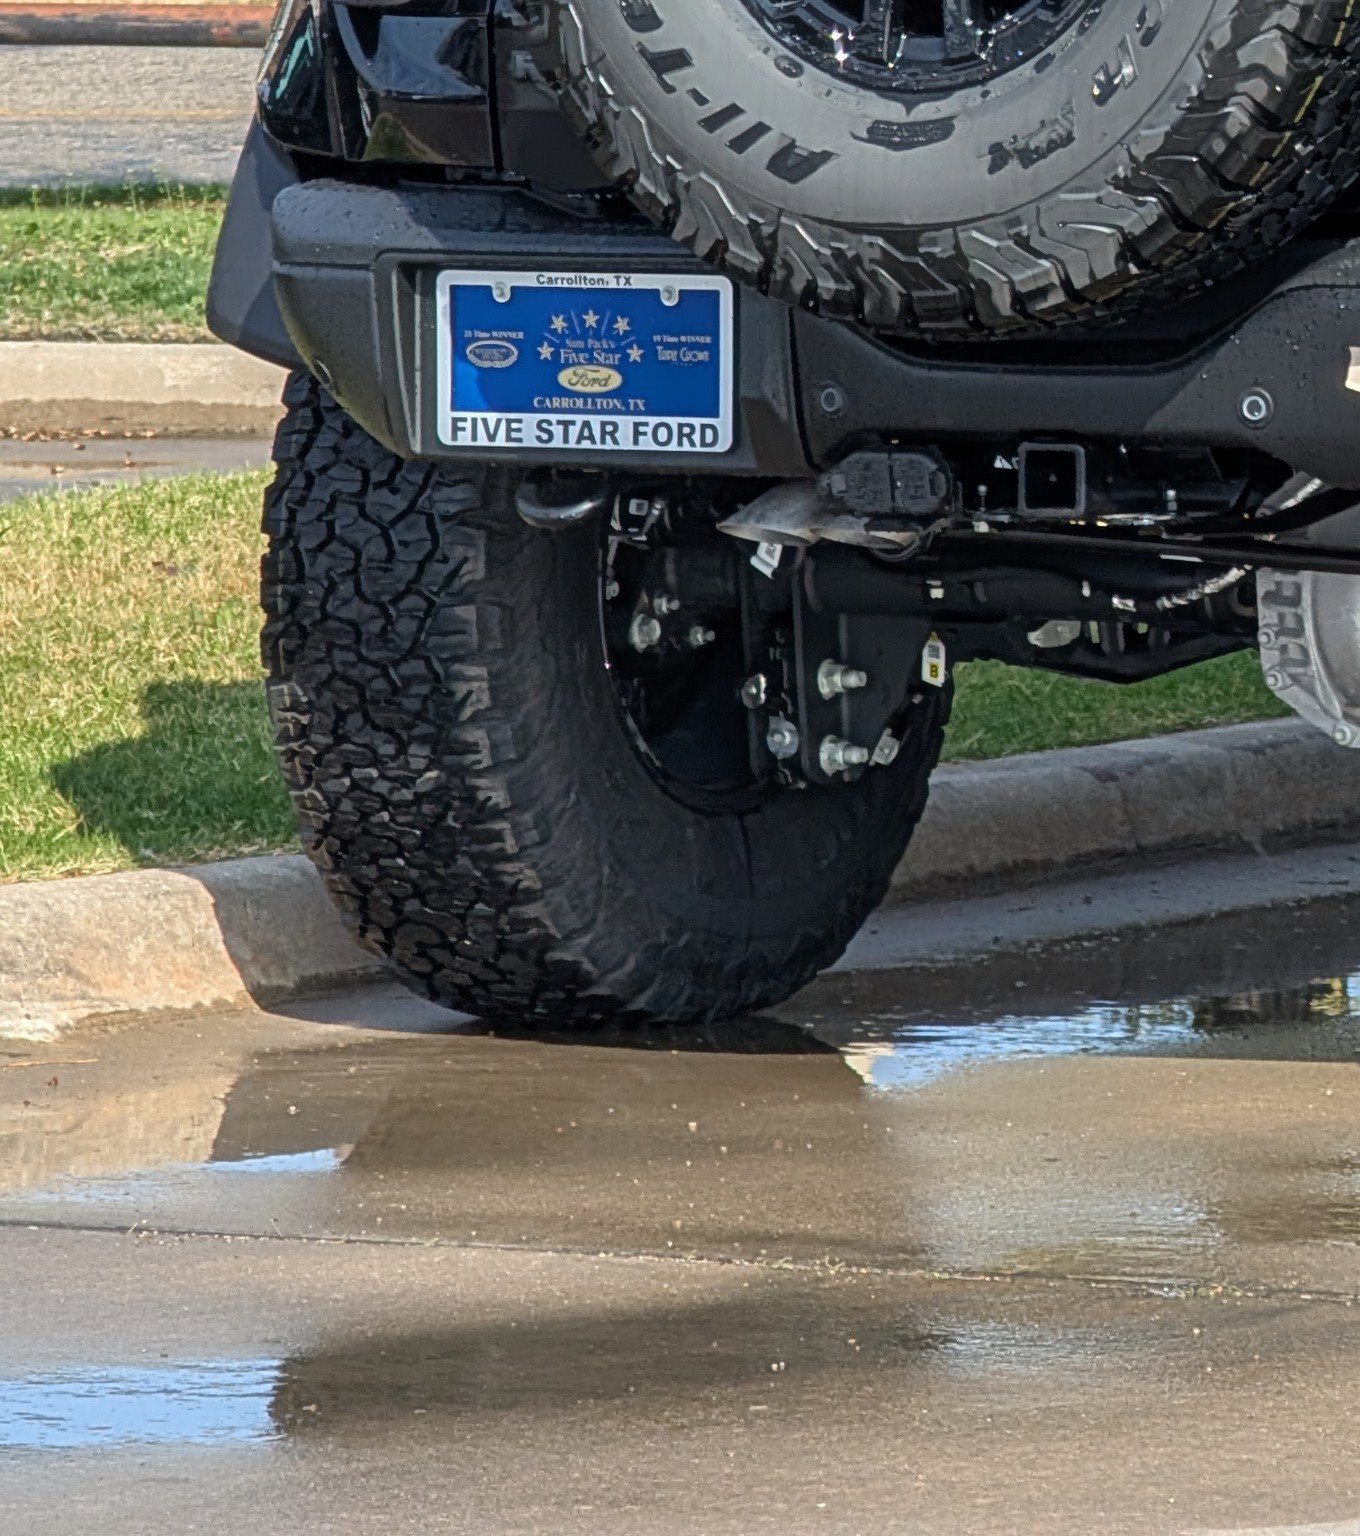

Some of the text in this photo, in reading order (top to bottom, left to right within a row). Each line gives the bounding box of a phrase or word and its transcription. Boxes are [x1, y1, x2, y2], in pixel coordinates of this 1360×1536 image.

[613, 275, 632, 287] TX
[560, 348, 622, 365] Five Star
[567, 367, 612, 387] Ford
[627, 398, 646, 412] TX
[450, 417, 720, 448] FIVE STAR FORD
